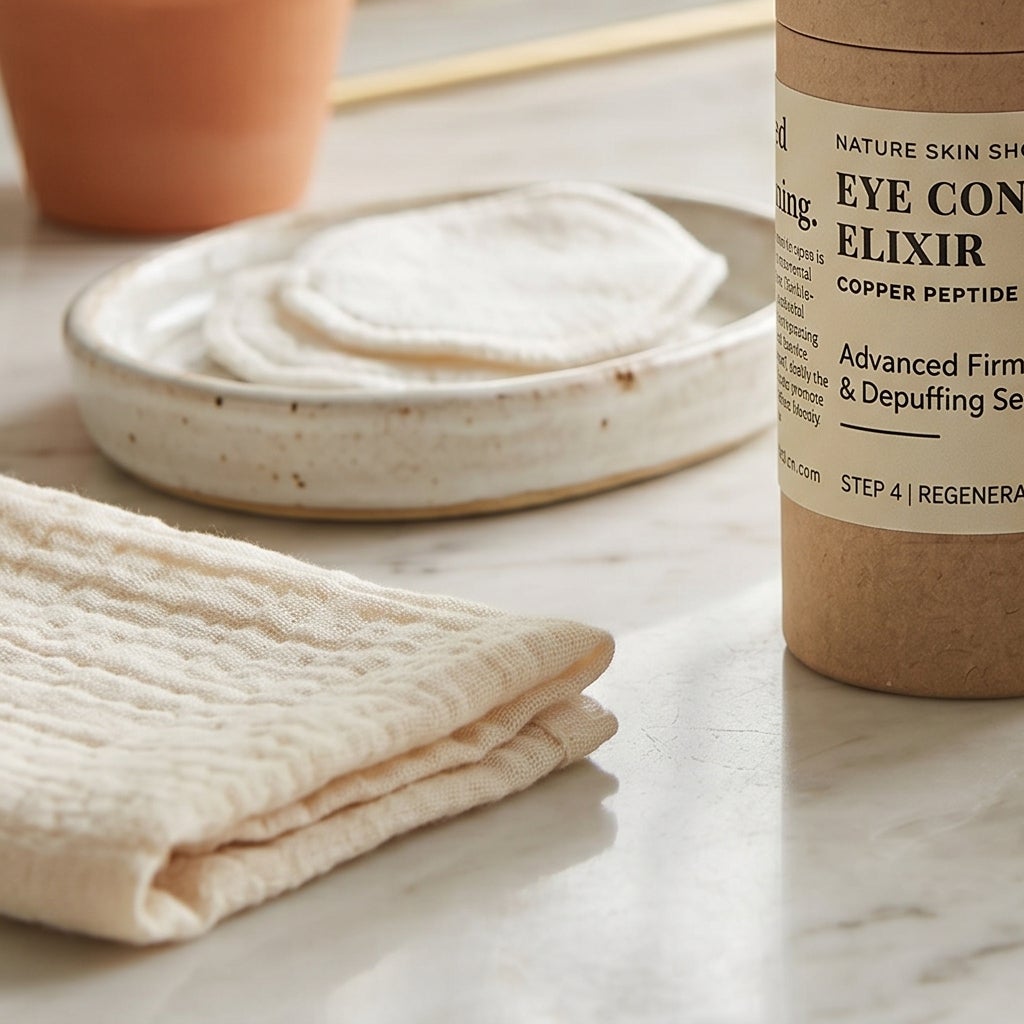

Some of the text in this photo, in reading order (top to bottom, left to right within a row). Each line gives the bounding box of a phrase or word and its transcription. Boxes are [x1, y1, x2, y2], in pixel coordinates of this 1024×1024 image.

[836, 133, 917, 159] NATURE
[925, 144, 979, 160] SKIN
[836, 171, 911, 214] EYE
[837, 222, 986, 267] ELIXIR
[837, 276, 916, 301] COPPER
[924, 286, 1018, 303] PEPTIDE
[839, 343, 957, 377] Advanced
[839, 375, 856, 402] &
[863, 380, 984, 418] Depuffing
[841, 474, 885, 499] STEP
[890, 483, 902, 501] 4
